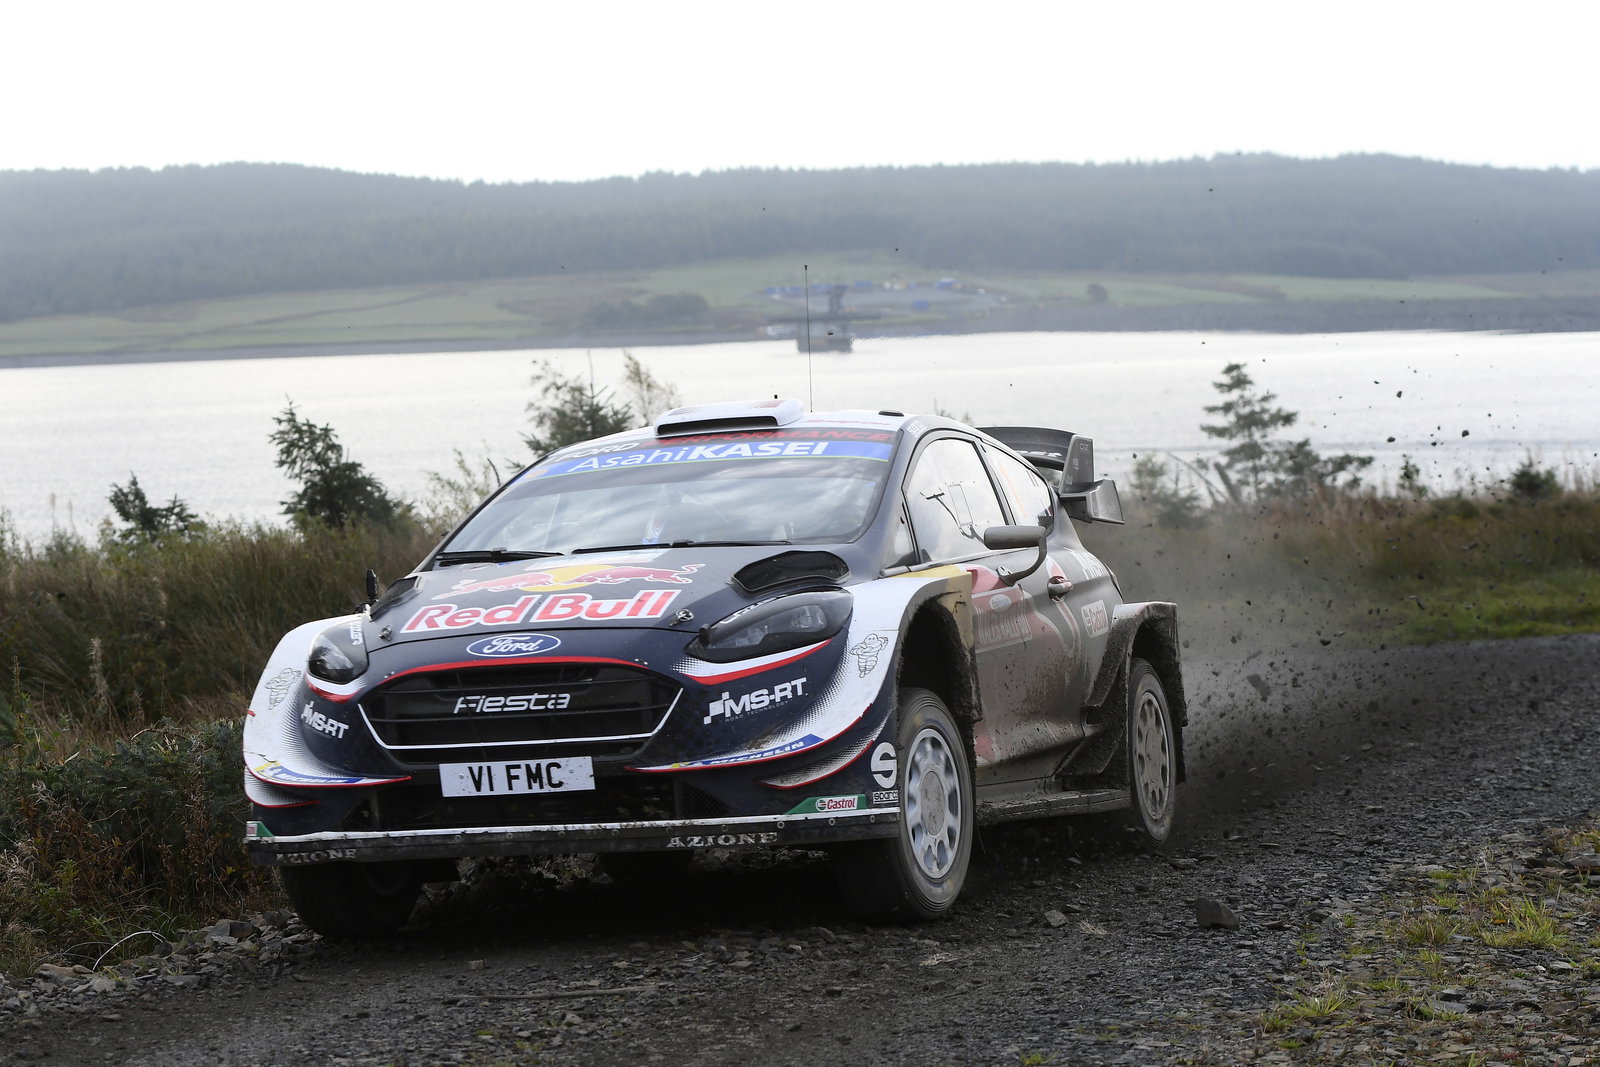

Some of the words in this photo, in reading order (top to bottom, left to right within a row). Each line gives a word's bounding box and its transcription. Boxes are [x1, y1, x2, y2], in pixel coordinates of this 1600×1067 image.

[401, 595, 541, 632] Red
[530, 590, 681, 622] Bull
[483, 636, 544, 654] Ford
[453, 693, 571, 714] Fiesta
[505, 762, 564, 791] FMC
[827, 798, 856, 810] Castrol
